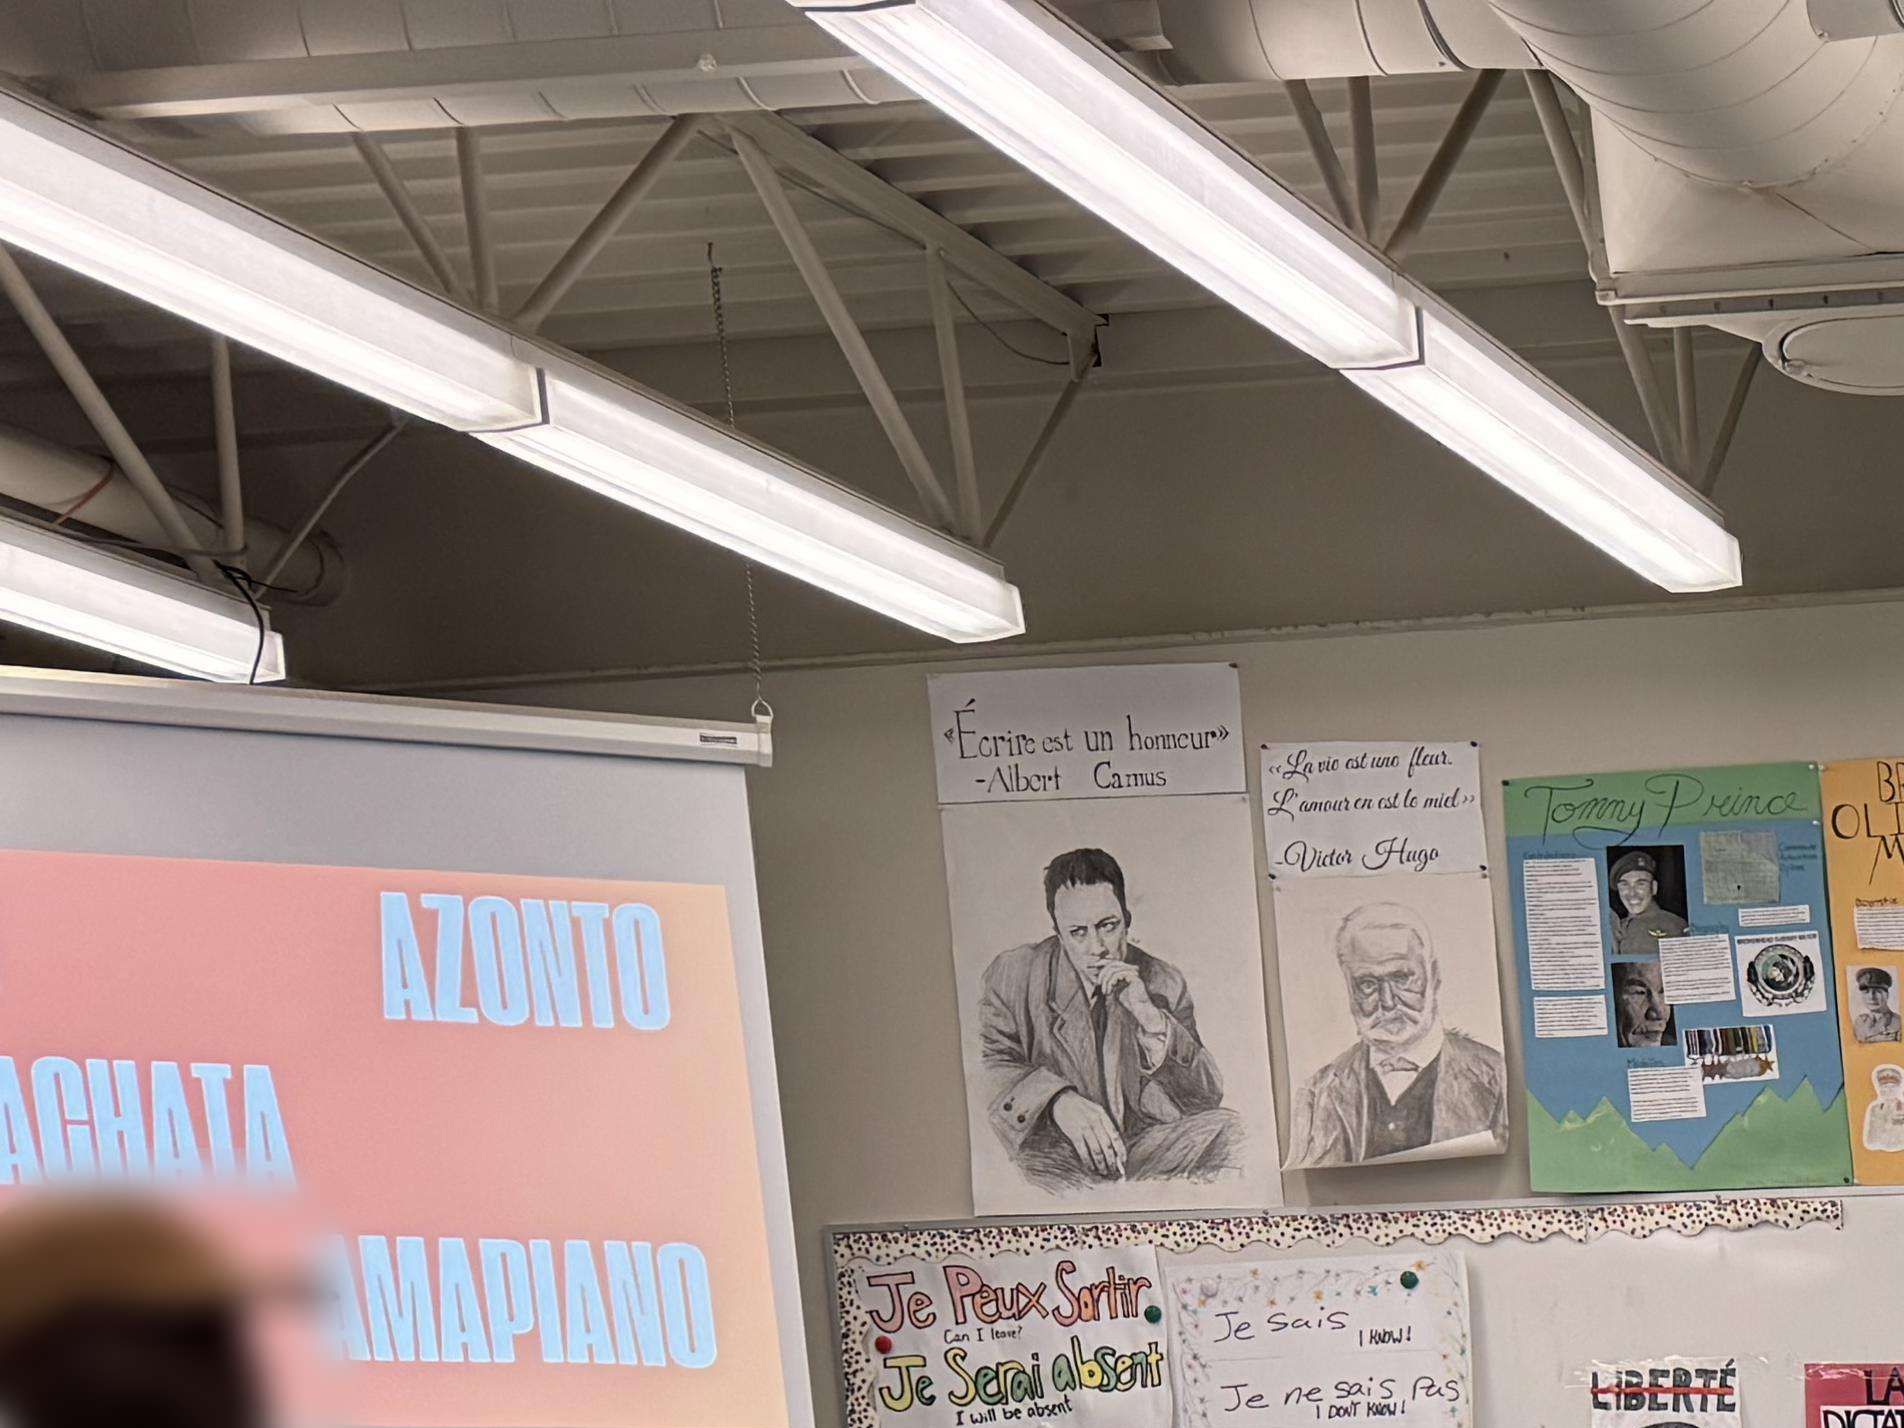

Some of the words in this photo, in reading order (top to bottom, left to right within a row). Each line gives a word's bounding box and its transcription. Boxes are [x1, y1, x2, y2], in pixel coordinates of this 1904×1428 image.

[1042, 728, 1074, 755] est
[1084, 728, 1114, 751] un
[1092, 760, 1168, 790] Camus
[1318, 758, 1339, 774] vie
[1345, 752, 1369, 770] est
[1370, 755, 1400, 769] une
[1353, 796, 1372, 810] en
[1377, 792, 1400, 810] est
[1402, 788, 1417, 808] le
[1524, 778, 1646, 851] Tommy
[1644, 773, 1808, 839] Prince
[1361, 836, 1440, 873] Hugo
[380, 891, 671, 1031] AZONTO
[325, 1234, 718, 1368] AMAPIANO
[866, 1271, 937, 1334] Je
[943, 1264, 1050, 1325] Peux
[1052, 1260, 1153, 1328] Sortir
[944, 1328, 964, 1345] Can
[976, 1328, 985, 1343] I
[1213, 1310, 1256, 1343] Je
[1358, 1330, 1364, 1348] I
[879, 1354, 938, 1412] Je
[944, 1346, 1046, 1407] Serai
[1052, 1334, 1165, 1394] absent
[1590, 1358, 1738, 1414] LIBERTÉ
[956, 1410, 966, 1426] I
[1003, 1405, 1023, 1421] be
[1027, 1393, 1074, 1419] absent
[1220, 1382, 1270, 1413] Je
[1283, 1385, 1325, 1407] ne
[1334, 1376, 1398, 1401] sais
[1316, 1403, 1321, 1420] I
